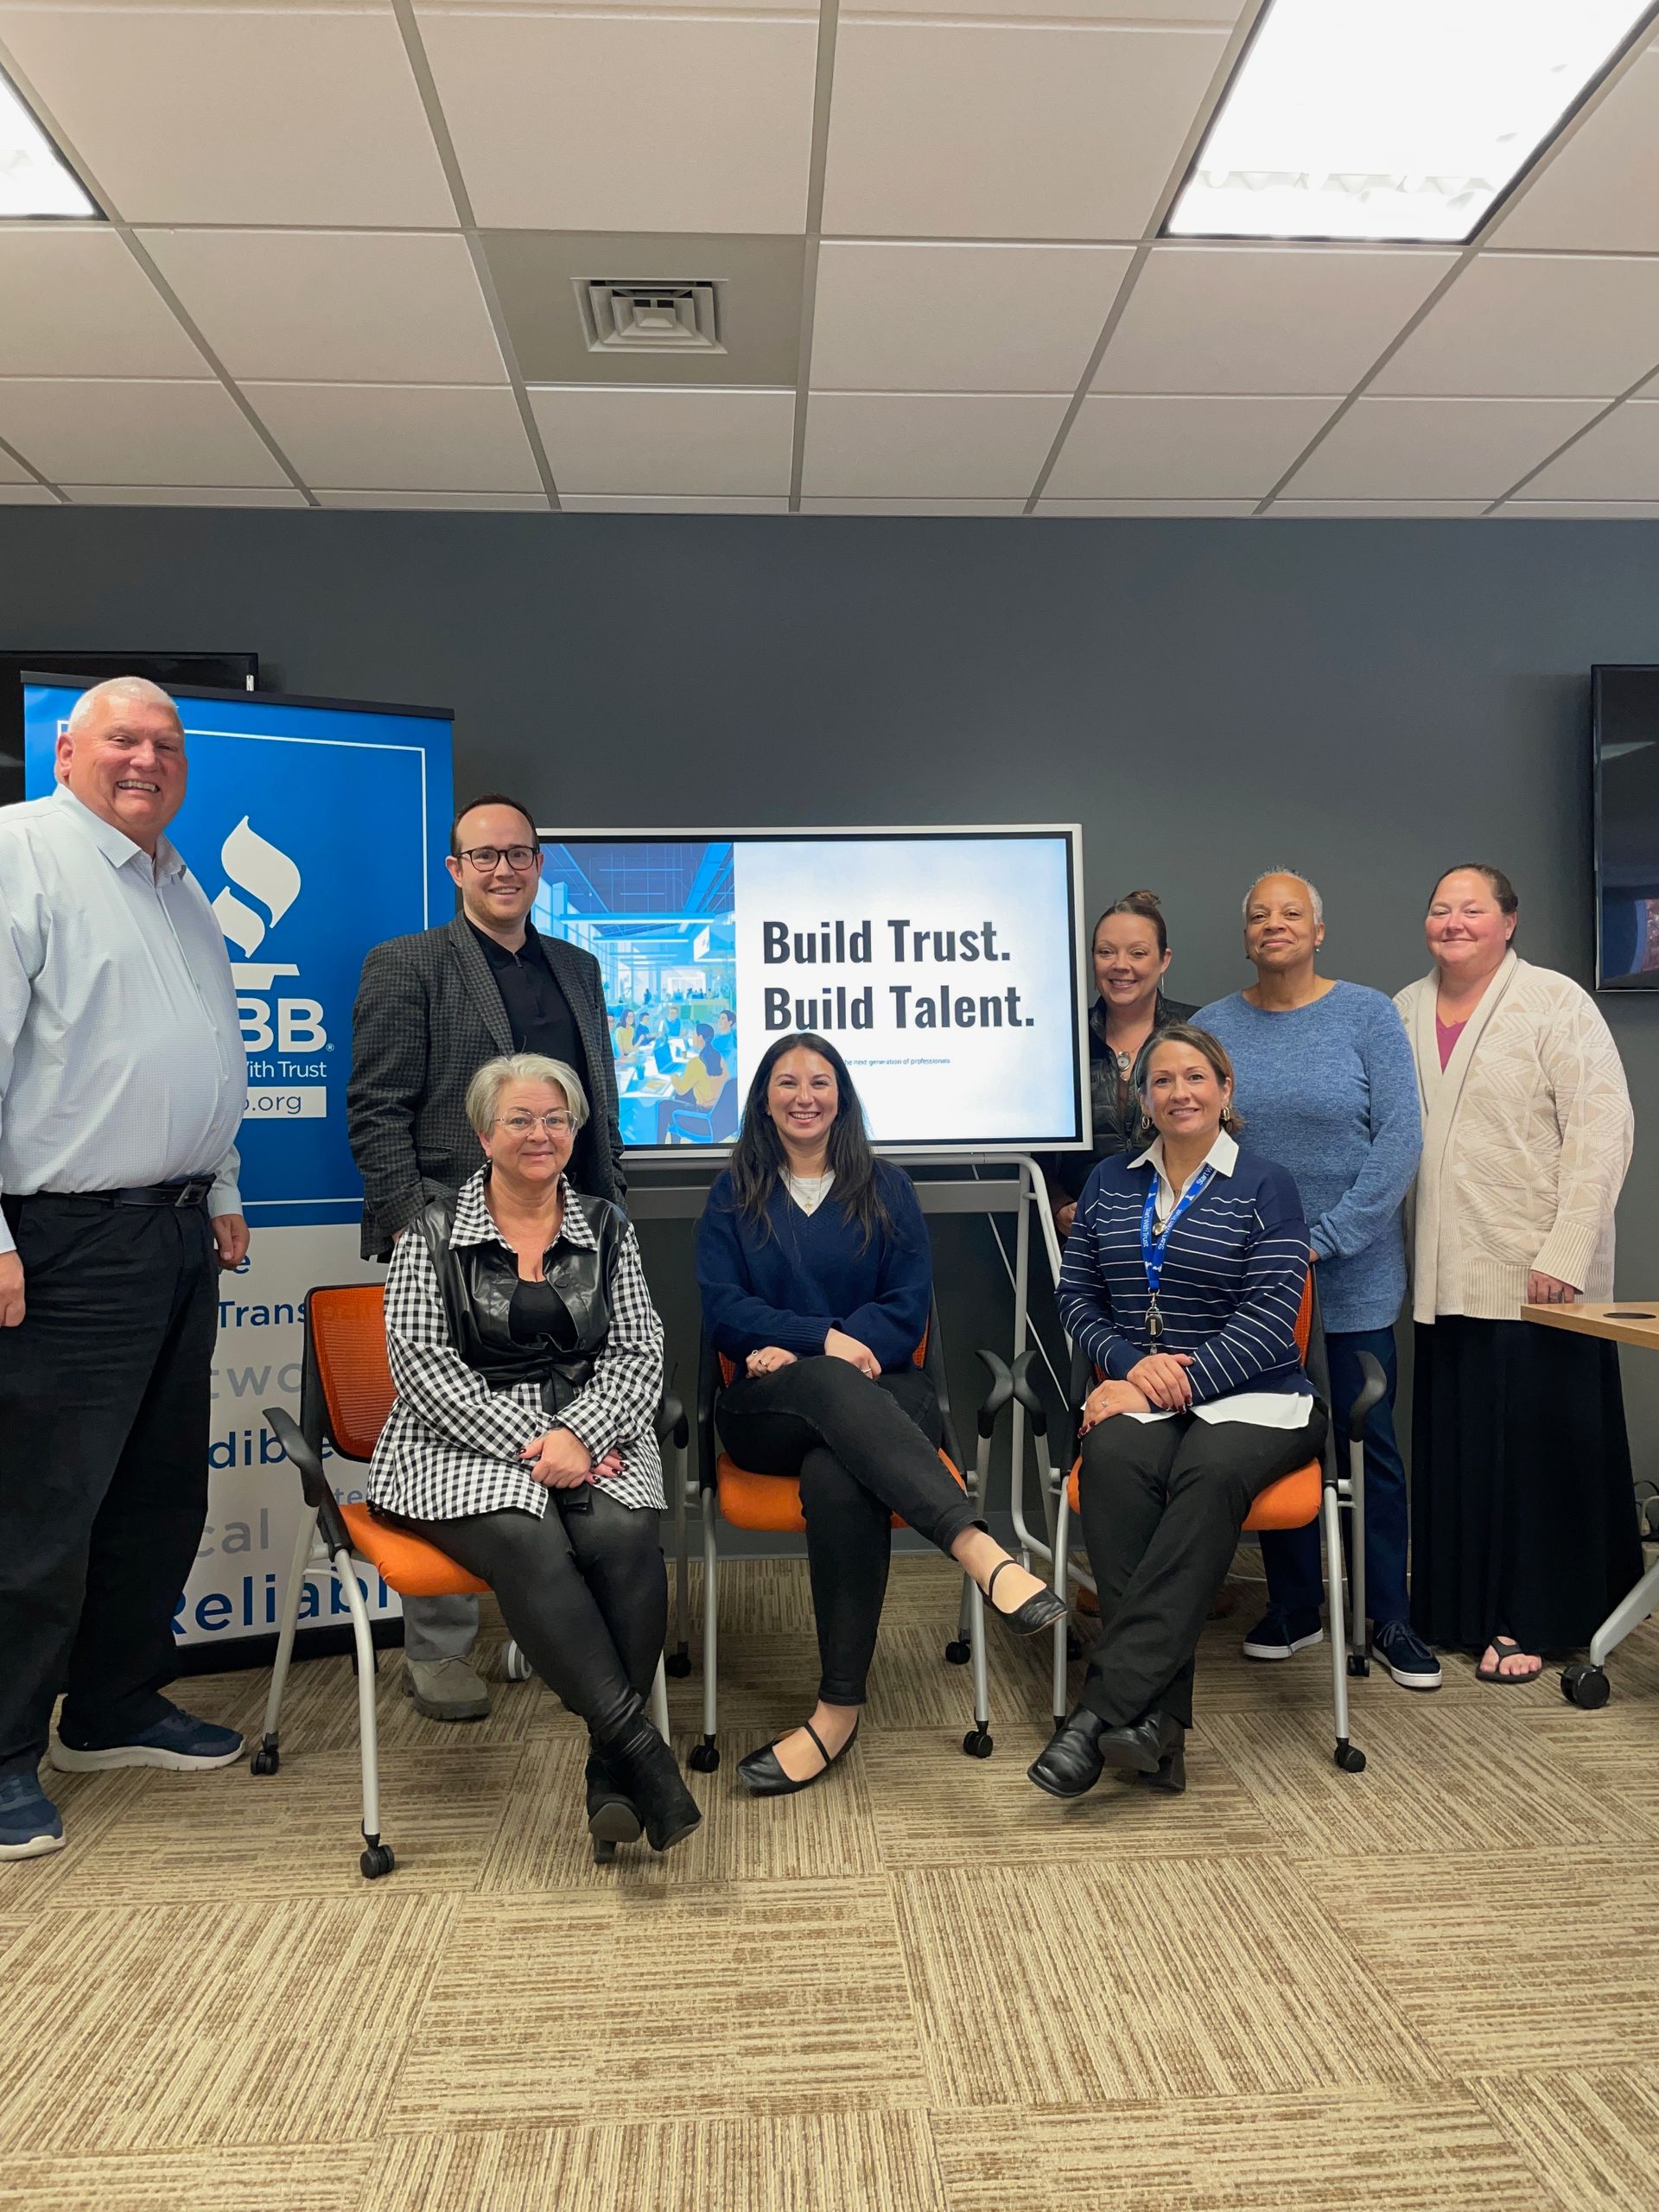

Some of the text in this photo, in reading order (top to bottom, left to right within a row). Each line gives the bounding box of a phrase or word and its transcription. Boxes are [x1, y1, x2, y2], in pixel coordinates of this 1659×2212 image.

[763, 919, 1010, 963] Build Trust.
[765, 985, 1034, 1030] Build Talent.
[247, 1060, 327, 1078] ith Trust
[869, 1058, 902, 1066] generation
